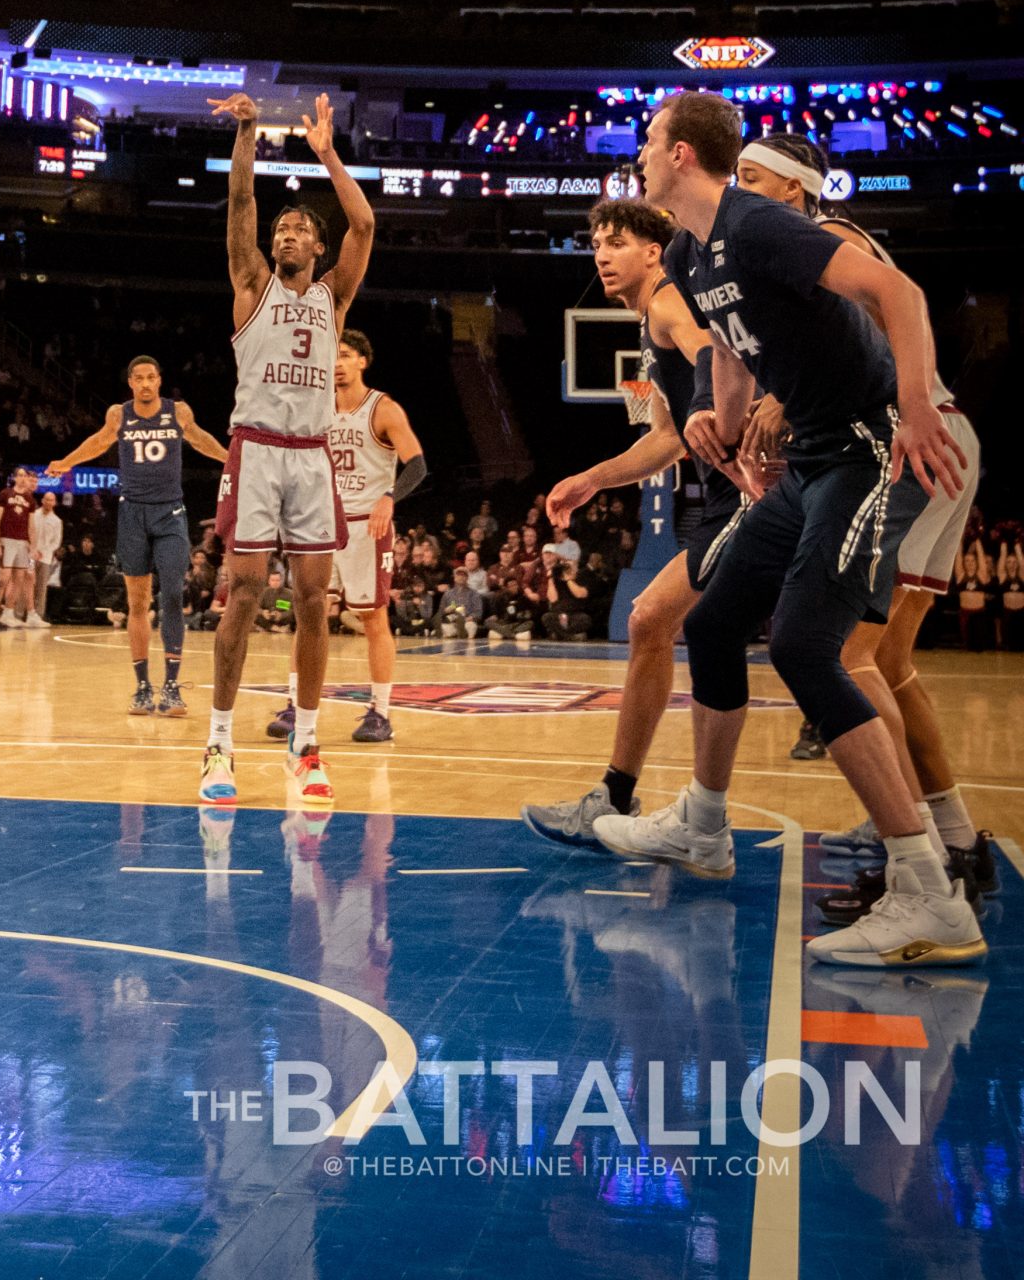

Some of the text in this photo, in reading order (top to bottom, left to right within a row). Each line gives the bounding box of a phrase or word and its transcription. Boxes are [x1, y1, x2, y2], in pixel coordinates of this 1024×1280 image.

[701, 45, 750, 61] NIT
[267, 164, 320, 174] TURNOVERS
[440, 180, 454, 197] 4
[506, 177, 558, 194] TEXAS
[559, 177, 602, 195] A&M
[859, 175, 911, 191] XAVIER
[291, 328, 312, 359] 3
[262, 362, 328, 391] AGGIES
[123, 428, 179, 440] XAVIER
[329, 428, 365, 448] EXAS
[133, 440, 167, 464] 10
[332, 449, 356, 471] 20
